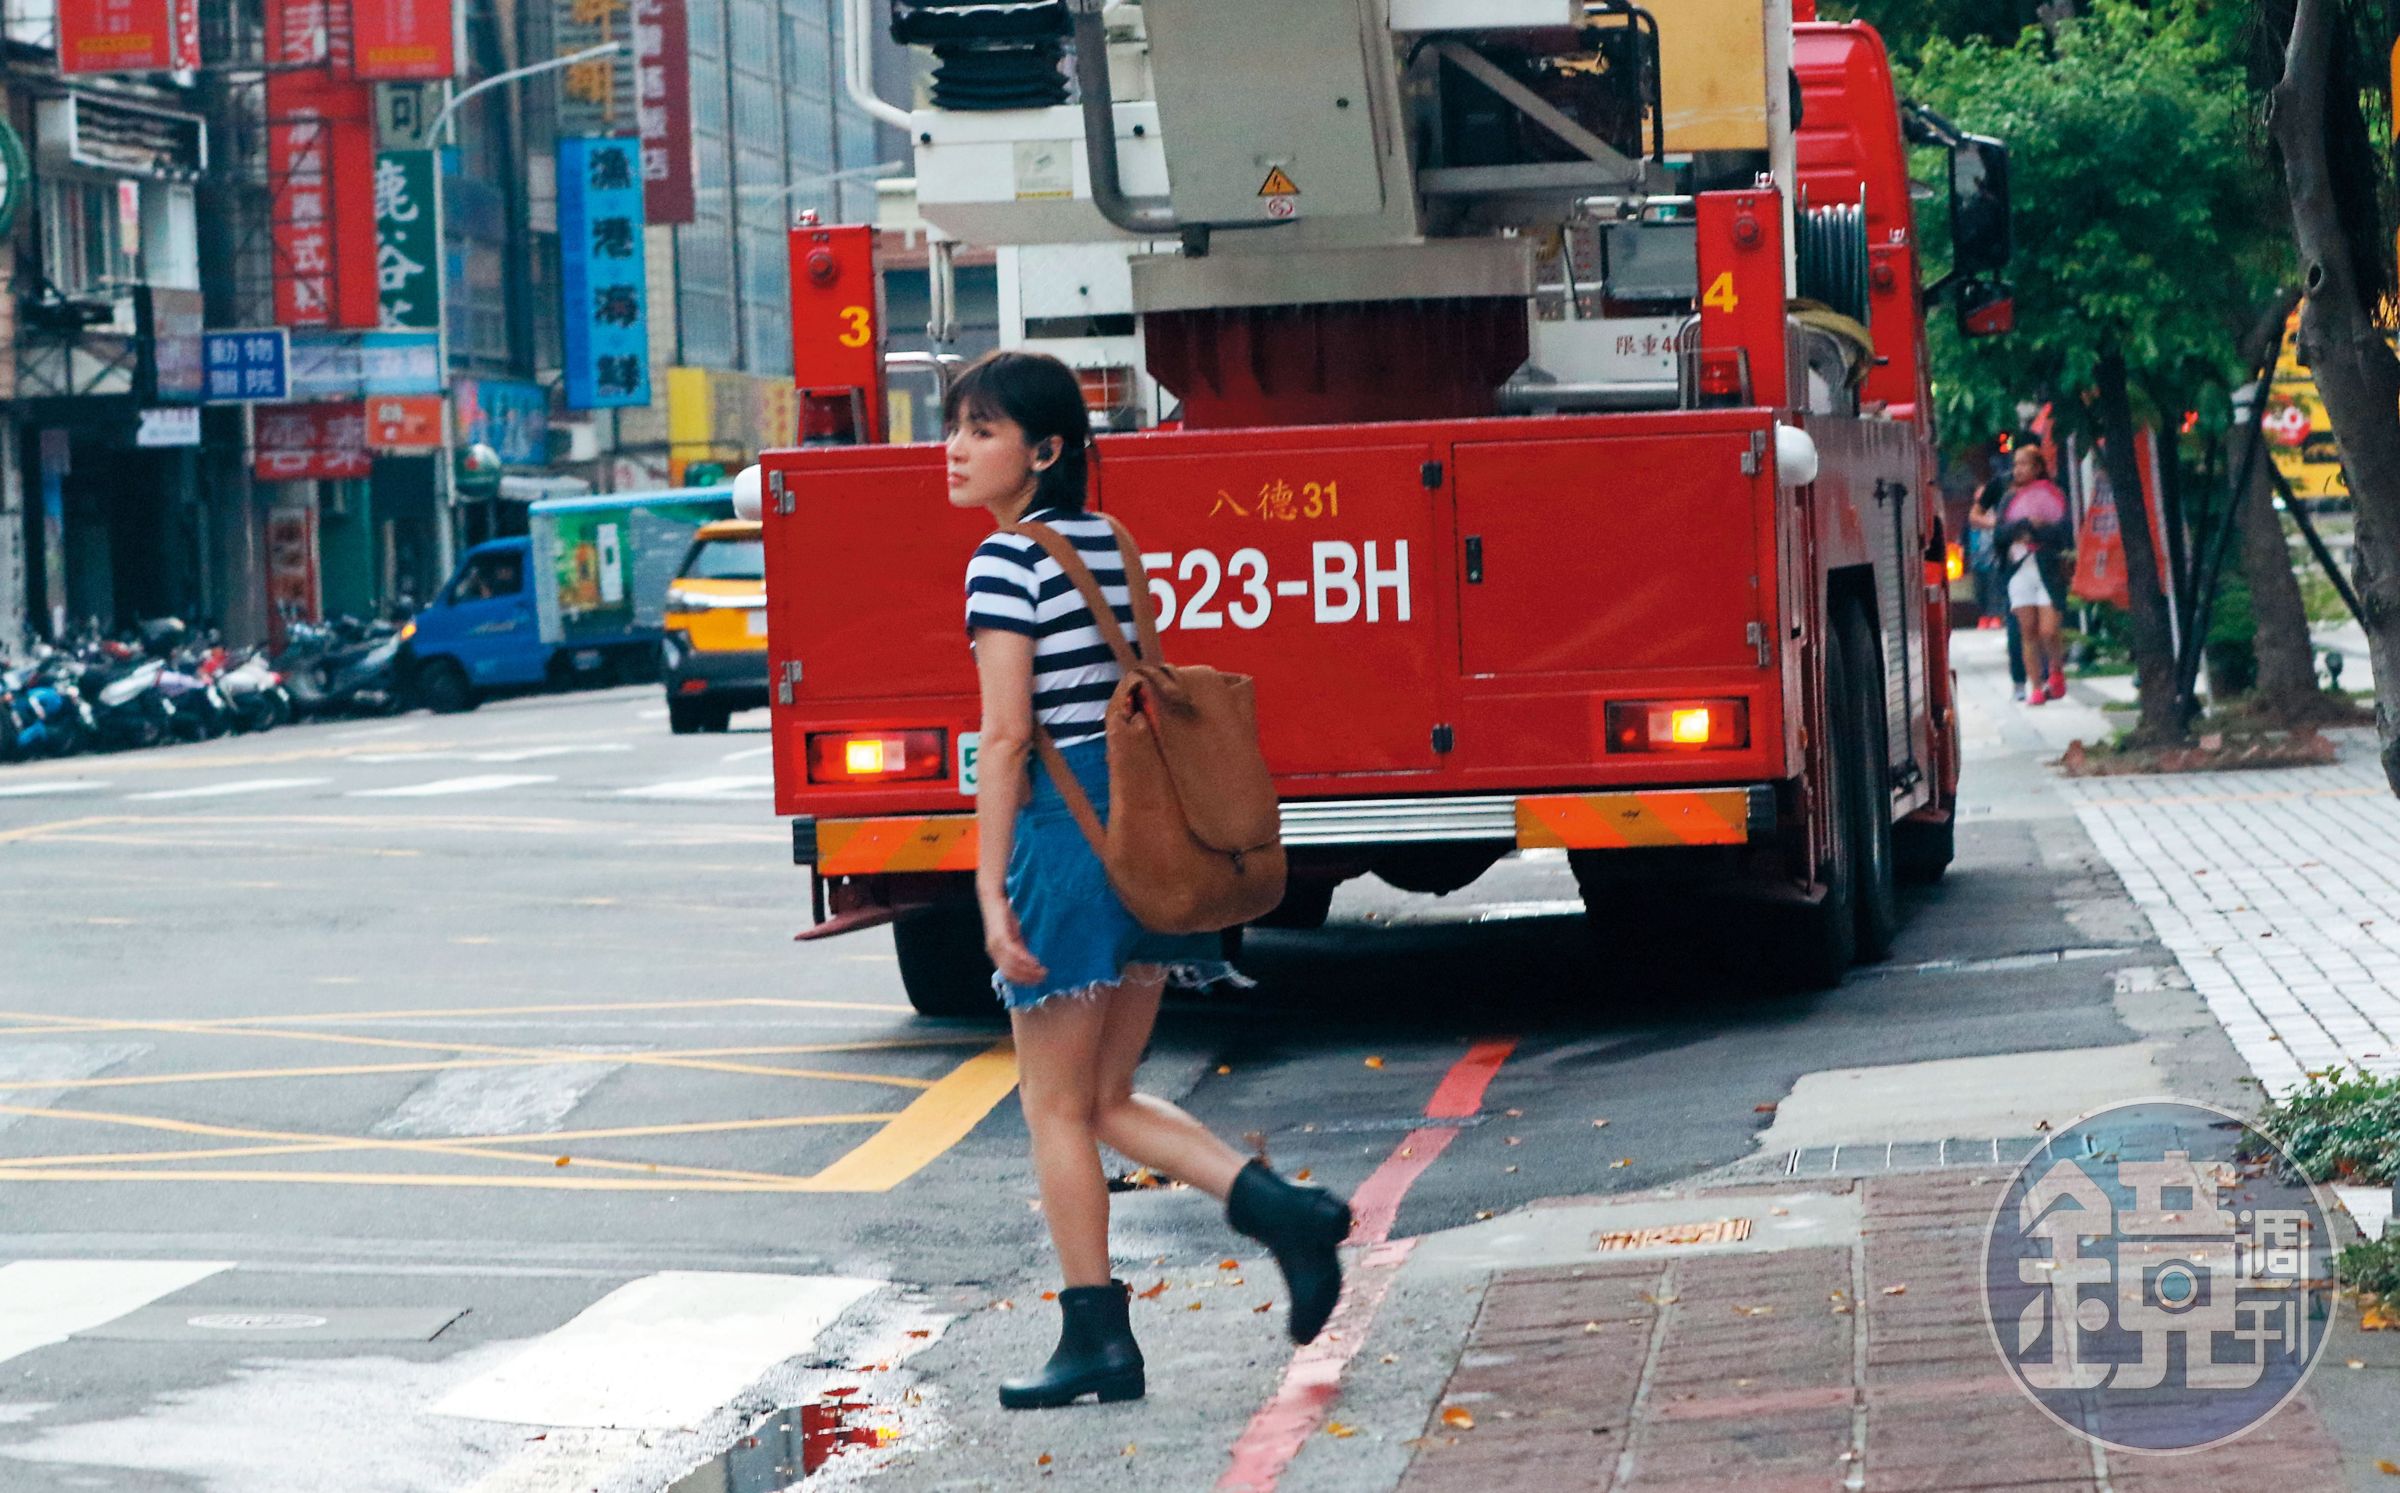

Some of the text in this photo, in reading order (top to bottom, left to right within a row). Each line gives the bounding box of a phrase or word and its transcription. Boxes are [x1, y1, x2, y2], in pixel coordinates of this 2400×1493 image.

[1703, 271, 1738, 313] 4
[839, 306, 871, 347] 3
[210, 337, 275, 363] 動物
[1209, 478, 1338, 522] 八德31
[1140, 538, 1411, 634] 523-BH
